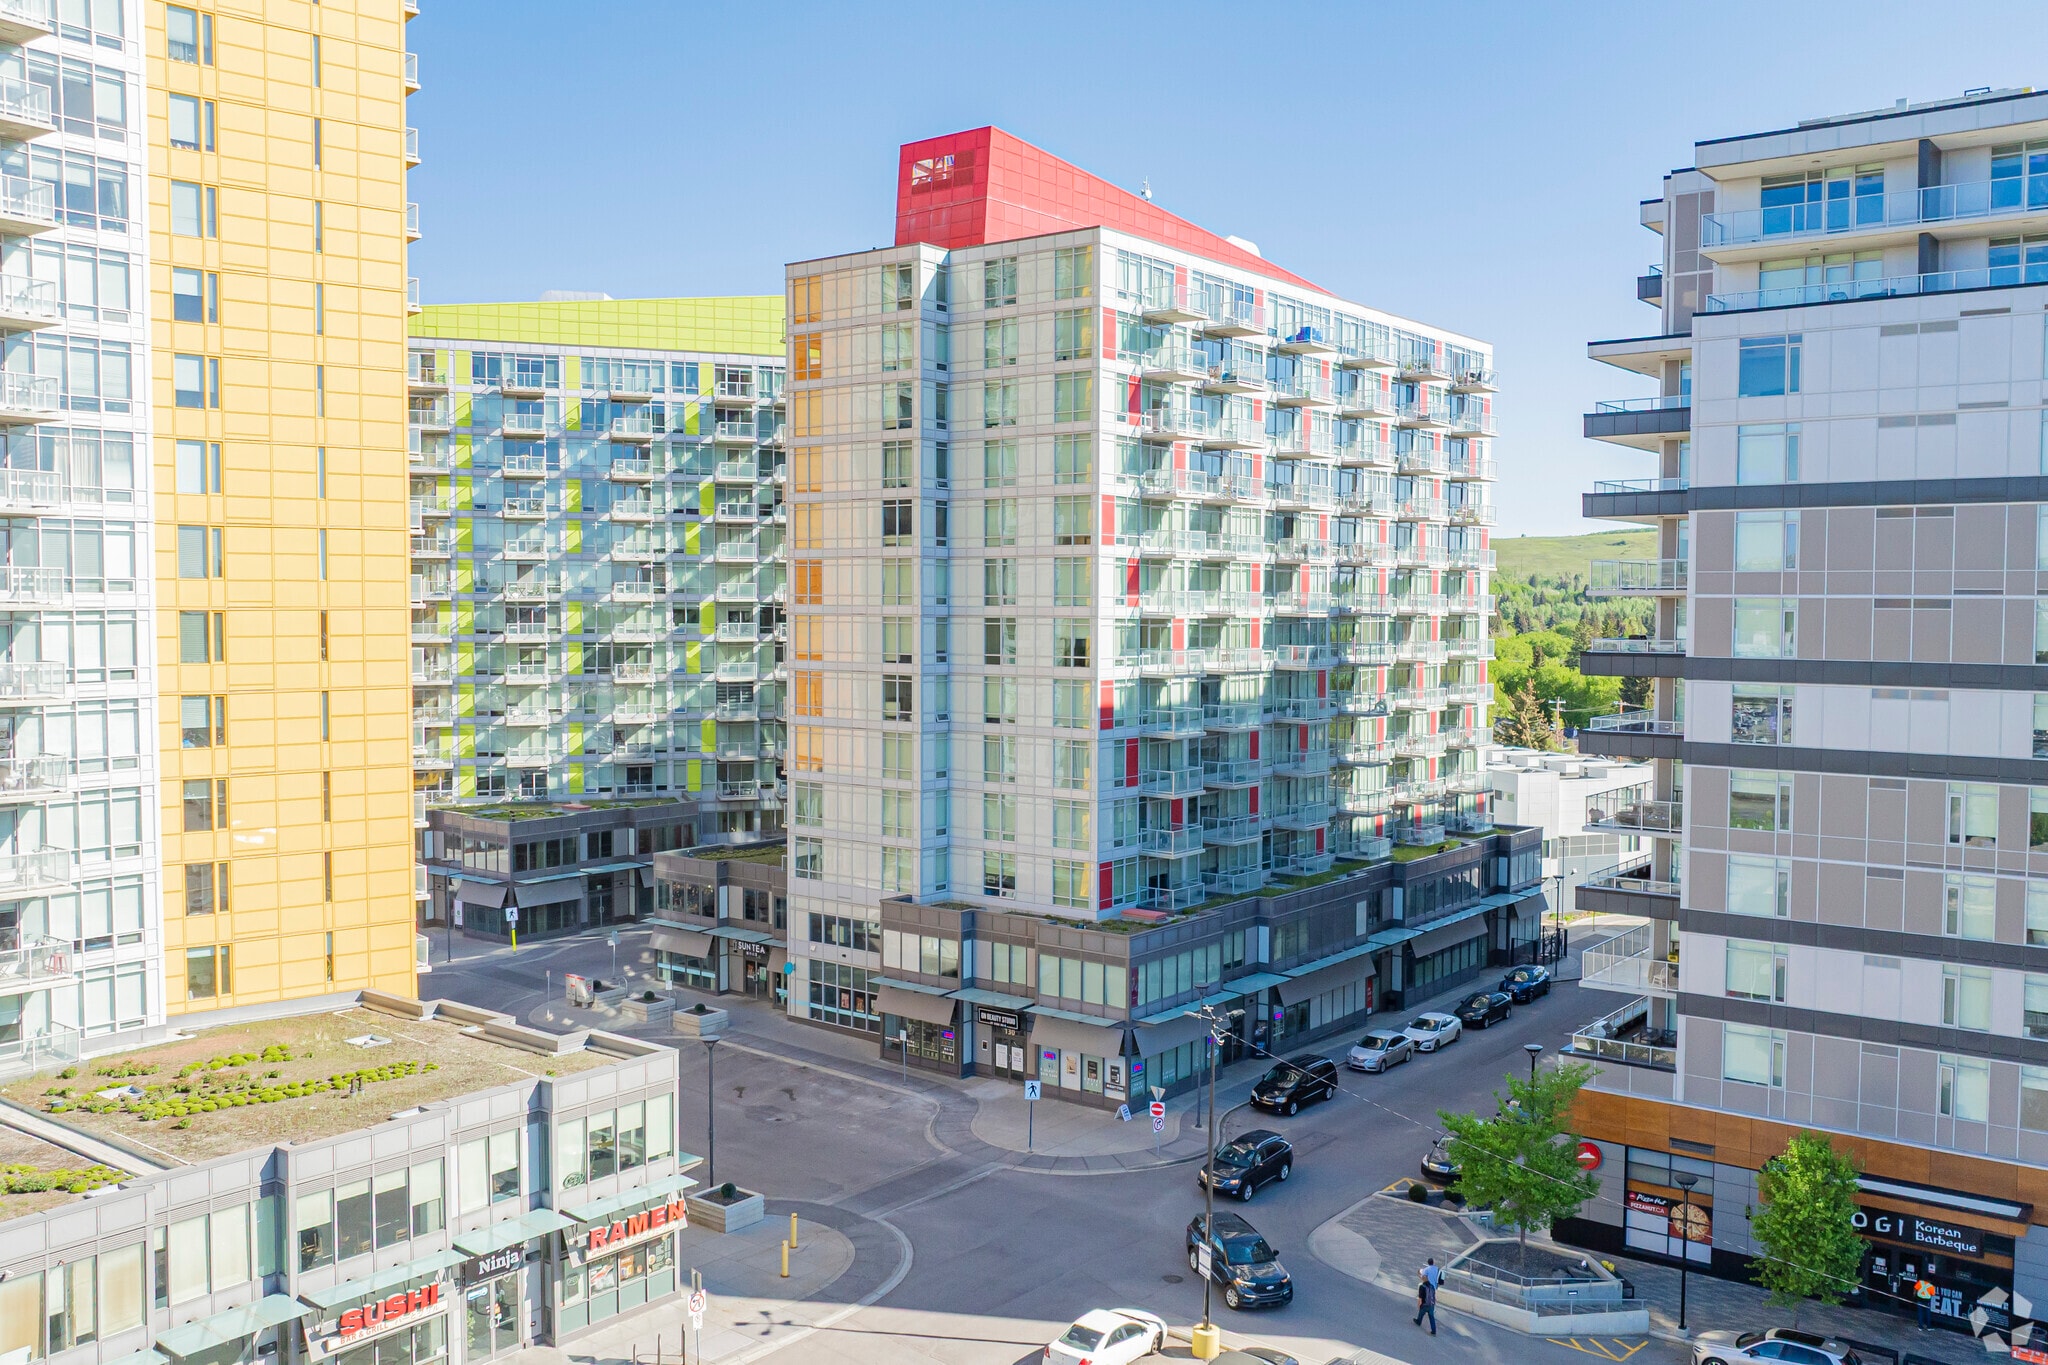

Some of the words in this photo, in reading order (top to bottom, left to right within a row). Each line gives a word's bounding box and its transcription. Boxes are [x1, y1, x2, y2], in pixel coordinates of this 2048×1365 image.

[751, 944, 766, 954] TEA
[1636, 1193, 1653, 1203] Pizza
[1654, 1198, 1668, 1206] Hut
[588, 1199, 685, 1251] RAMEN
[1850, 1212, 1904, 1236] OGI
[1915, 1220, 1962, 1239] Korean
[1915, 1231, 1977, 1252] Barbeque
[478, 1249, 520, 1275] Ninja
[1940, 1287, 1951, 1297] YOU
[1951, 1289, 1963, 1300] CAN
[339, 1282, 439, 1336] SUSHI
[1930, 1295, 1962, 1318] EAT
[340, 1333, 357, 1345] BAR
[365, 1322, 389, 1335] GRILL
